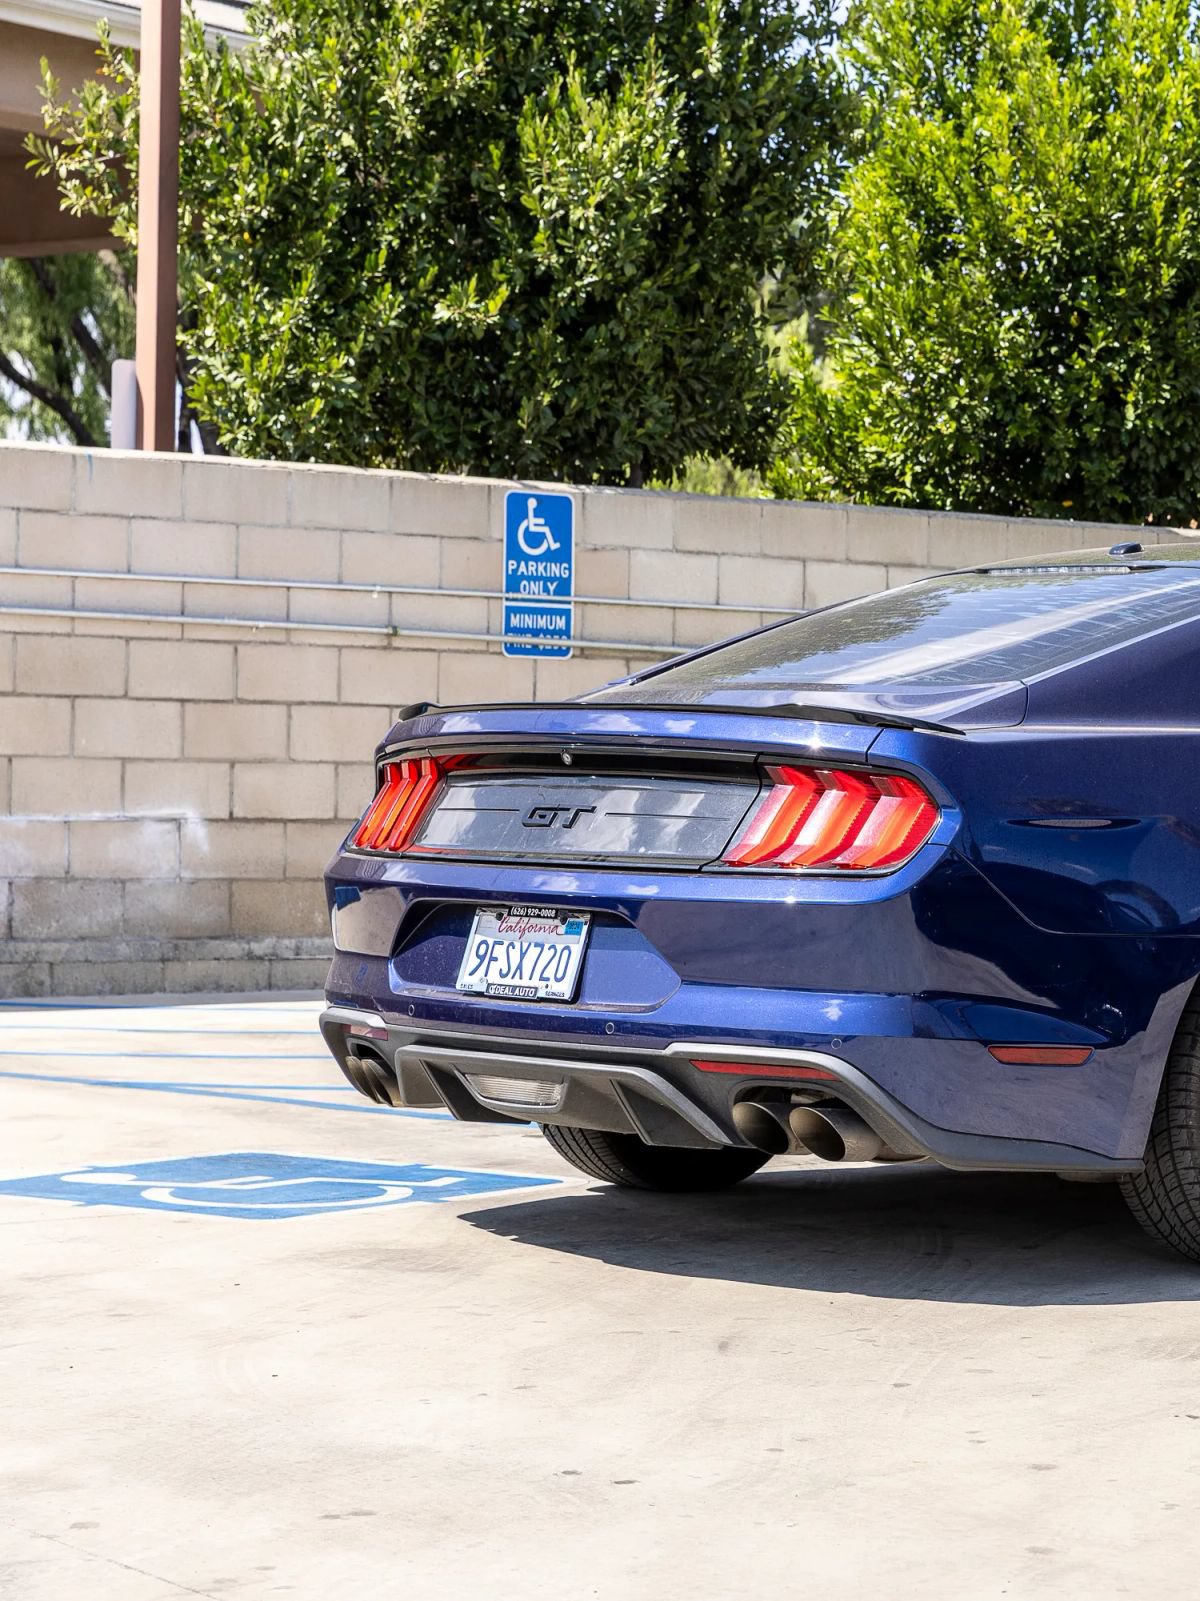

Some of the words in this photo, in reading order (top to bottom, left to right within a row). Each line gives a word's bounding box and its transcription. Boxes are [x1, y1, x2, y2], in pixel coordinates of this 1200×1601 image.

[507, 559, 569, 578] PARKING
[519, 580, 559, 595] ONLY
[509, 612, 566, 630] MINIMUM
[522, 804, 597, 829] GT
[498, 915, 566, 940] California
[468, 939, 572, 983] 9FSX720
[514, 986, 535, 997] AUTO
